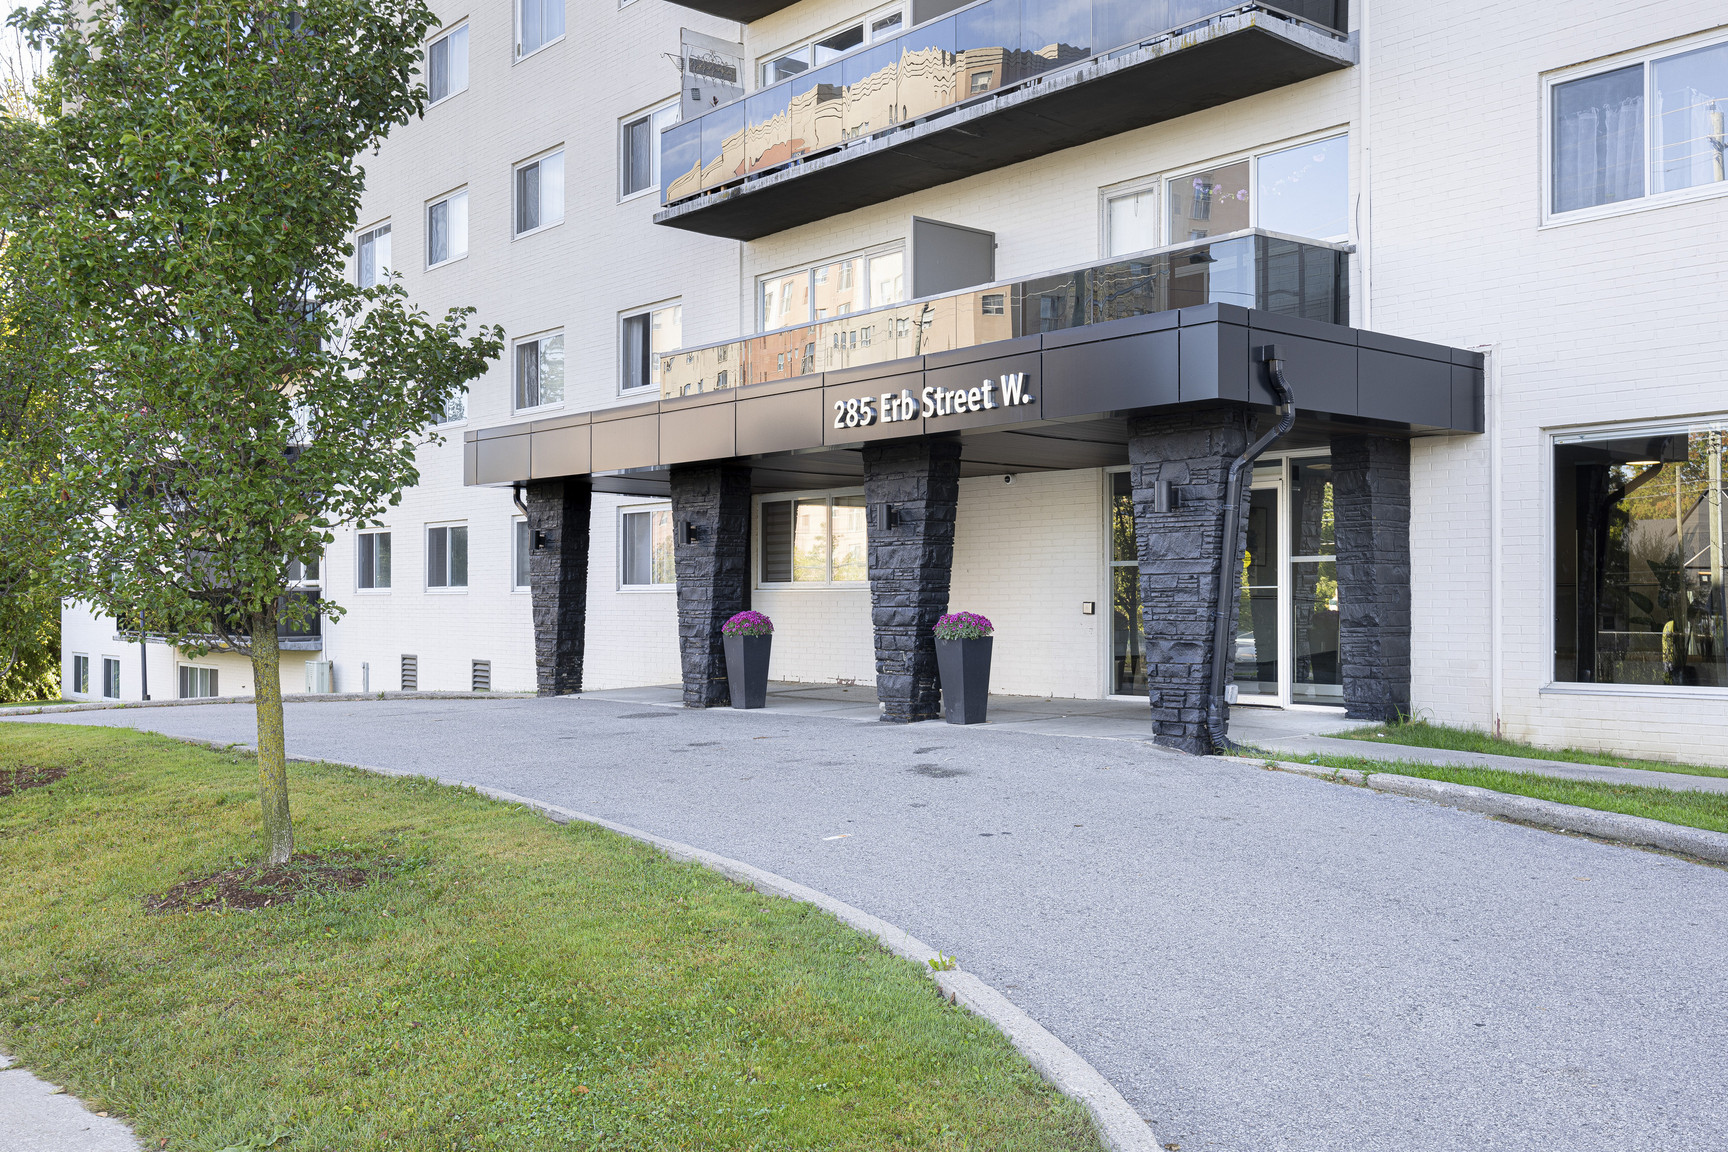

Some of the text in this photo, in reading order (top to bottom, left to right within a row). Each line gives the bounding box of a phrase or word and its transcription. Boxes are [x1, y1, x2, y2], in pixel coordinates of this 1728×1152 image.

[833, 372, 1035, 429] 285 Erb Street W.
